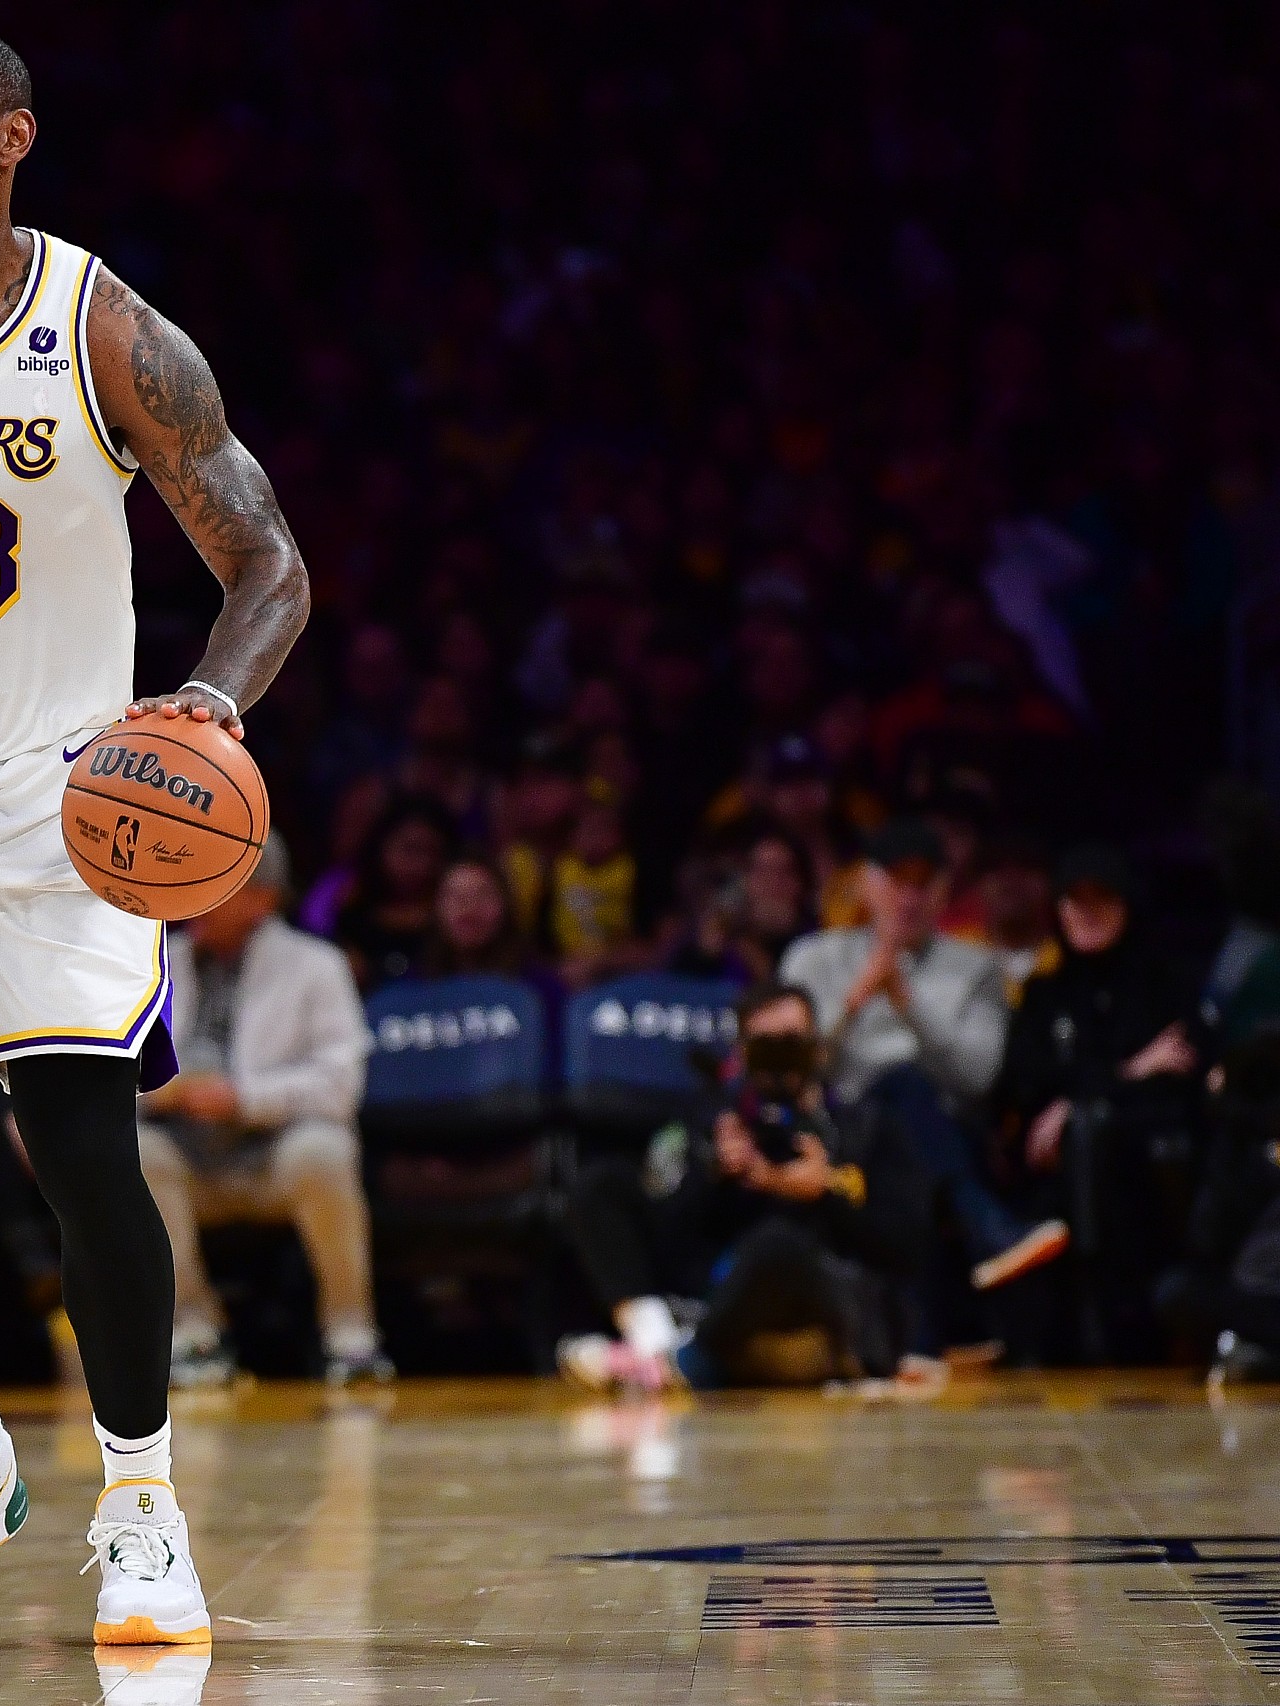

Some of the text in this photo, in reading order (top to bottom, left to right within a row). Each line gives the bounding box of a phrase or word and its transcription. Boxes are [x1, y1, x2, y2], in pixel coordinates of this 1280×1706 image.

[17, 356, 70, 376] bibigo
[89, 746, 214, 816] Wilson
[631, 1000, 739, 1043] DELT
[137, 1492, 155, 1515] BU
